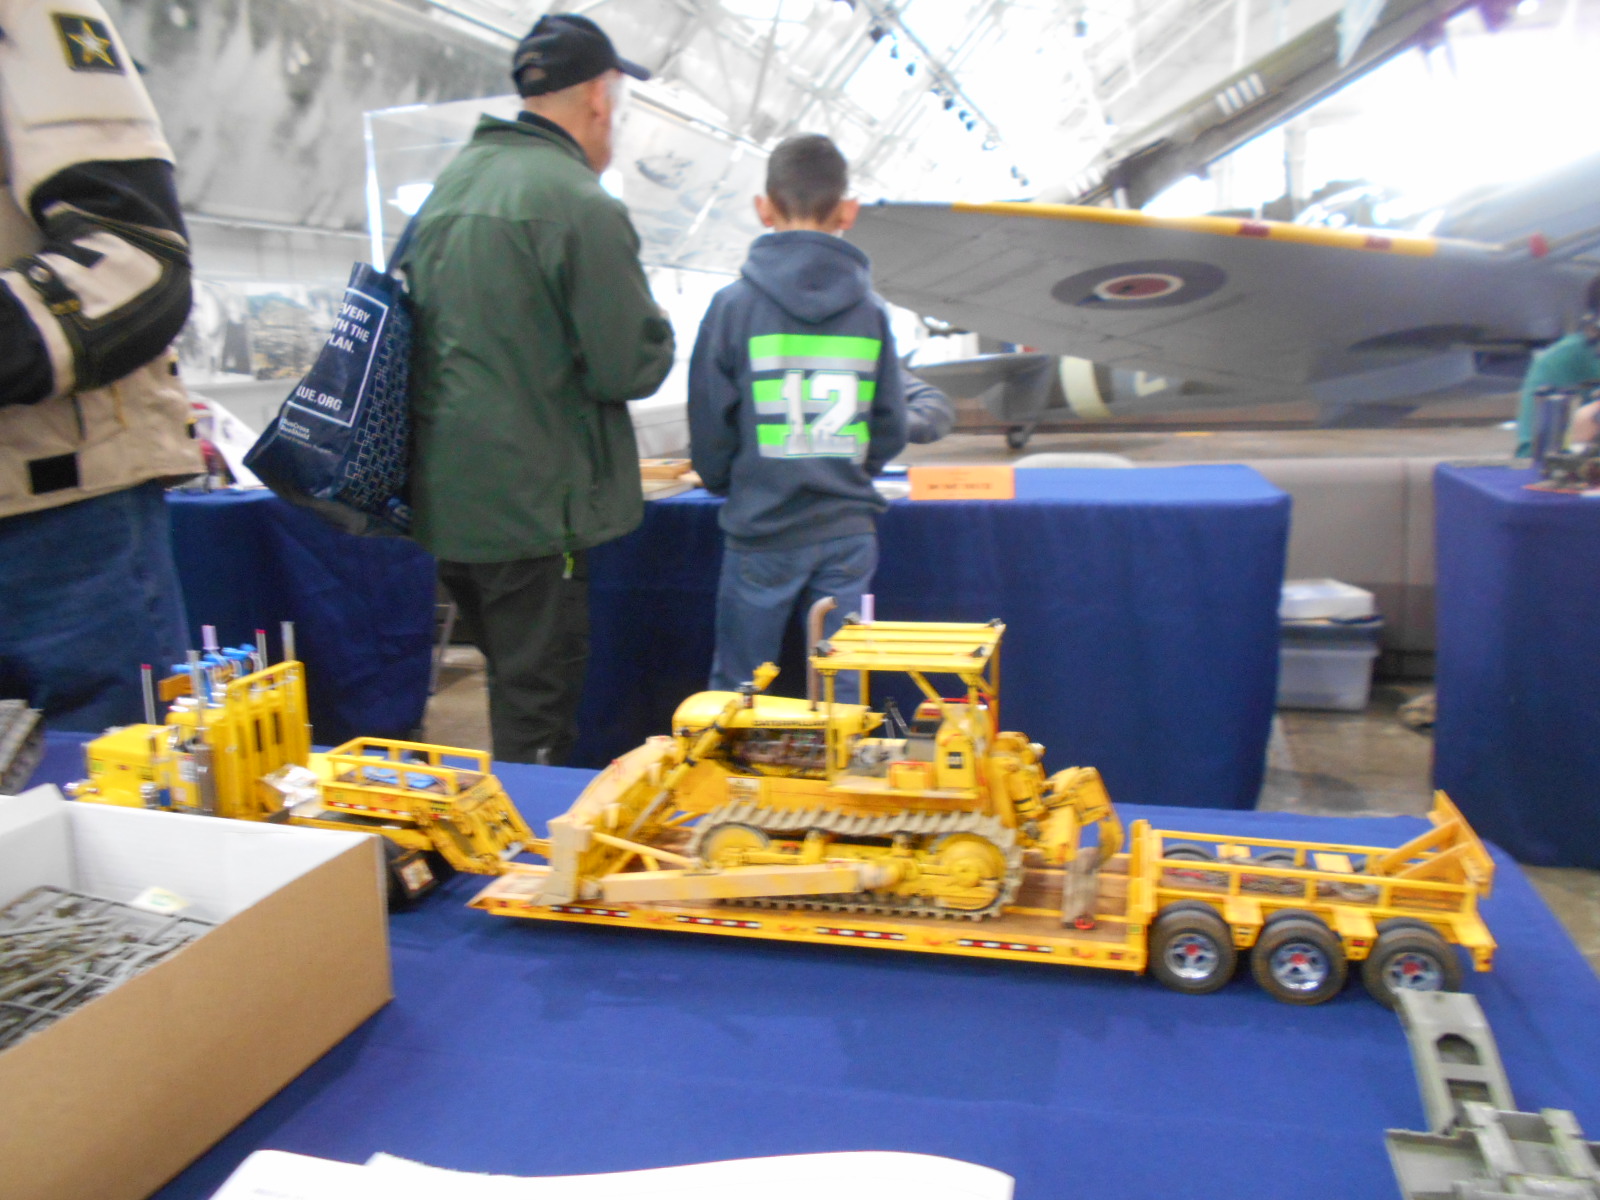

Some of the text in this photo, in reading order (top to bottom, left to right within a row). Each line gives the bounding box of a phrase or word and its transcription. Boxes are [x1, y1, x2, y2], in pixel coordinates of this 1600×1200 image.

[327, 333, 354, 353] LAN.
[350, 323, 370, 343] THE
[781, 369, 859, 458] 12
